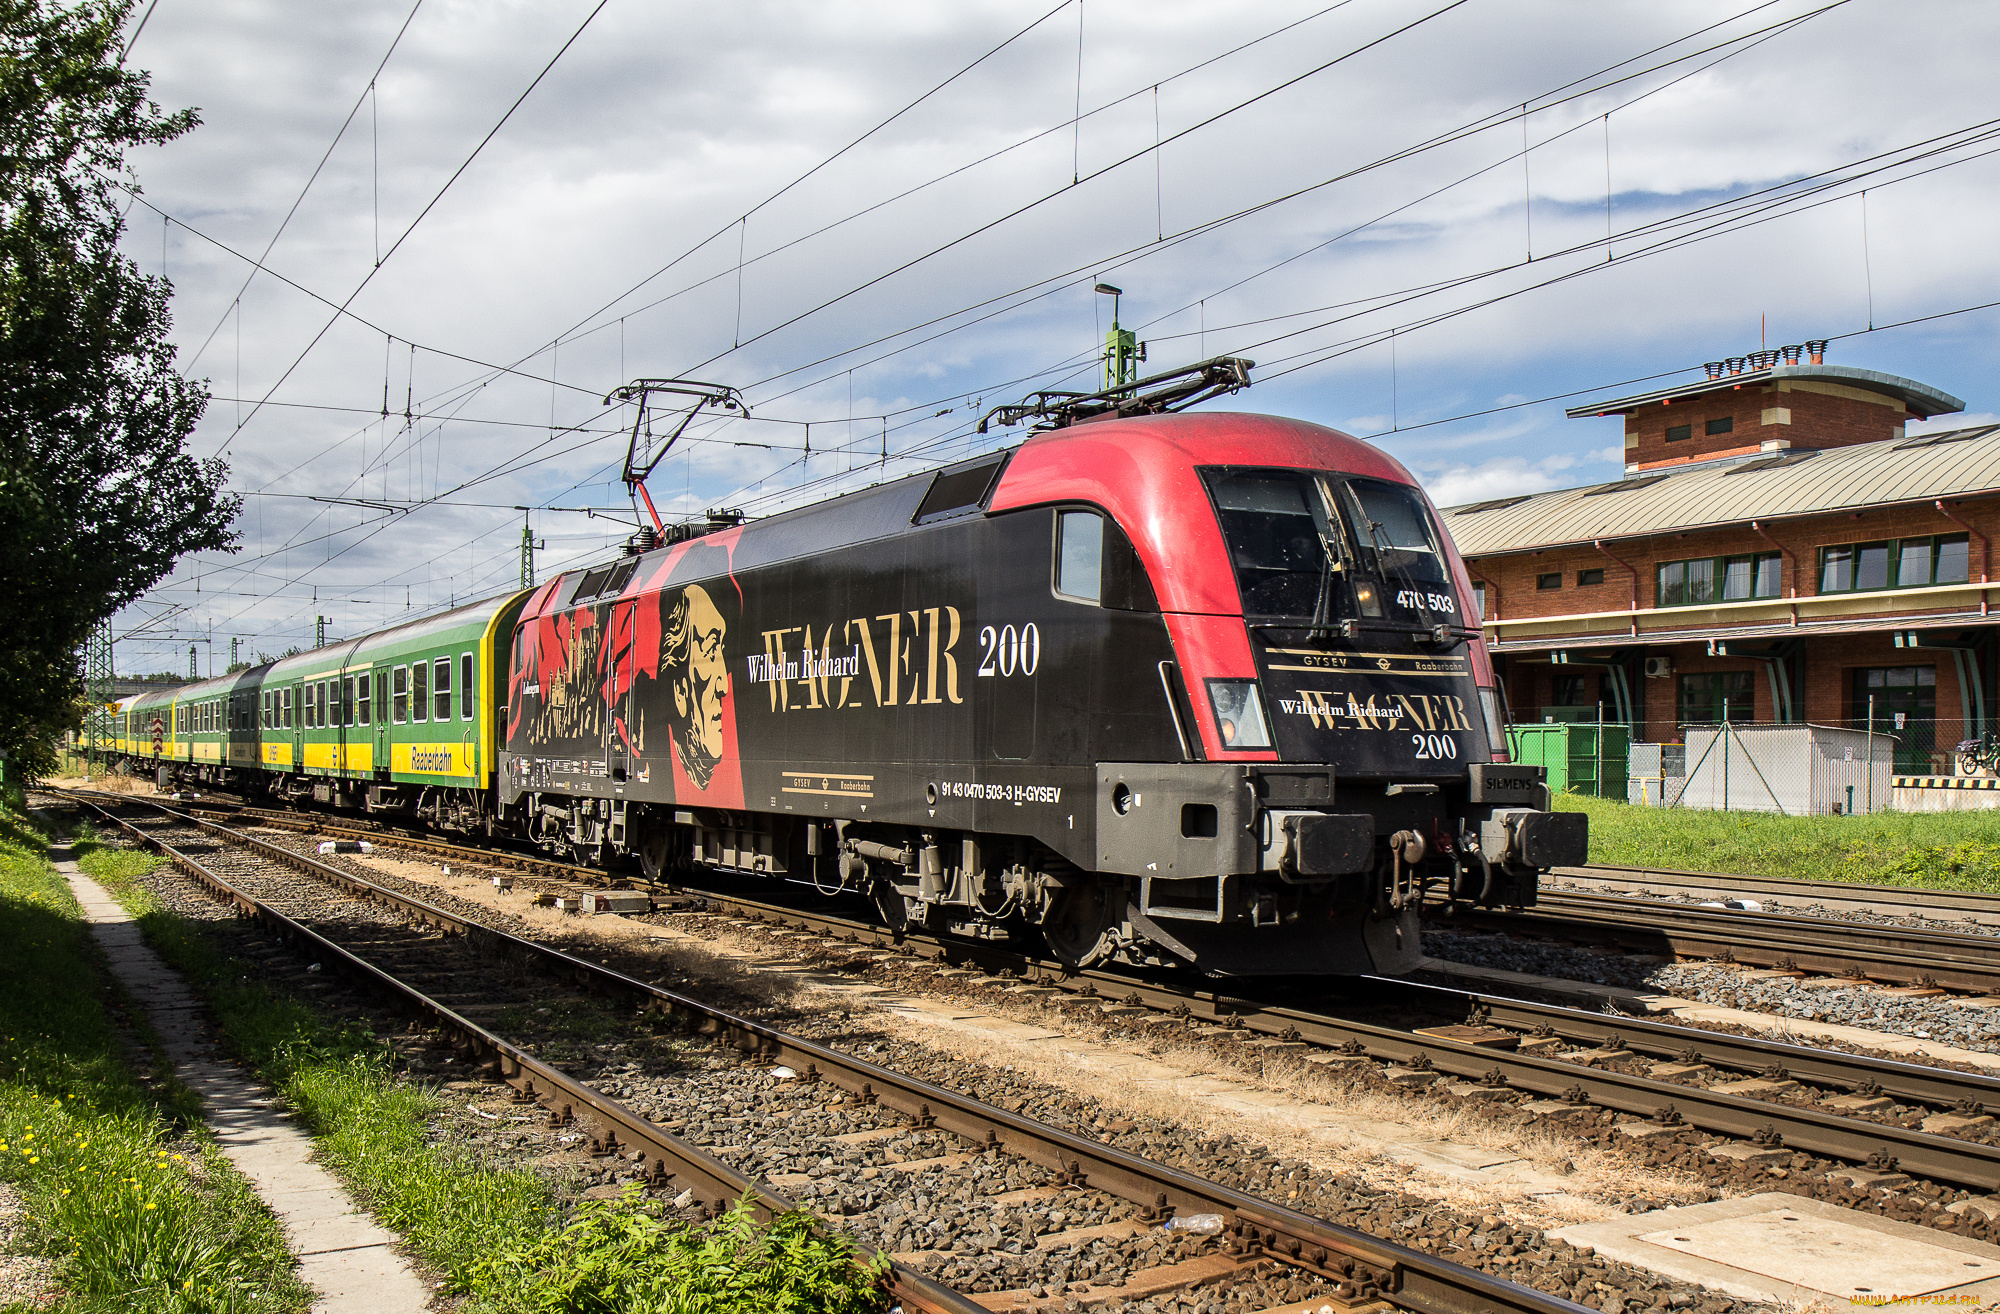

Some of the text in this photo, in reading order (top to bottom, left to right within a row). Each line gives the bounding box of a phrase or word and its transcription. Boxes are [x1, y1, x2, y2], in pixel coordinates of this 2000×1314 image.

[1397, 590, 1455, 613] 470 503
[761, 605, 963, 713] WAGNER
[977, 622, 1040, 677] 200
[746, 643, 859, 684] Wilhelm Richard
[1303, 656, 1463, 671] GYSEV Raaberbahn
[111, 703, 118, 714] 8
[1278, 699, 1404, 719] Wilhelm Richard
[1295, 690, 1474, 732] WAGNER
[1412, 734, 1457, 760] 200
[411, 746, 452, 772] Raaberbahn
[793, 778, 811, 788] GYSEV
[941, 782, 1061, 805] 91 43 0470 503-3 H-GYSEV
[1486, 778, 1532, 791] SIEMENS
[1067, 814, 1074, 830] 1
